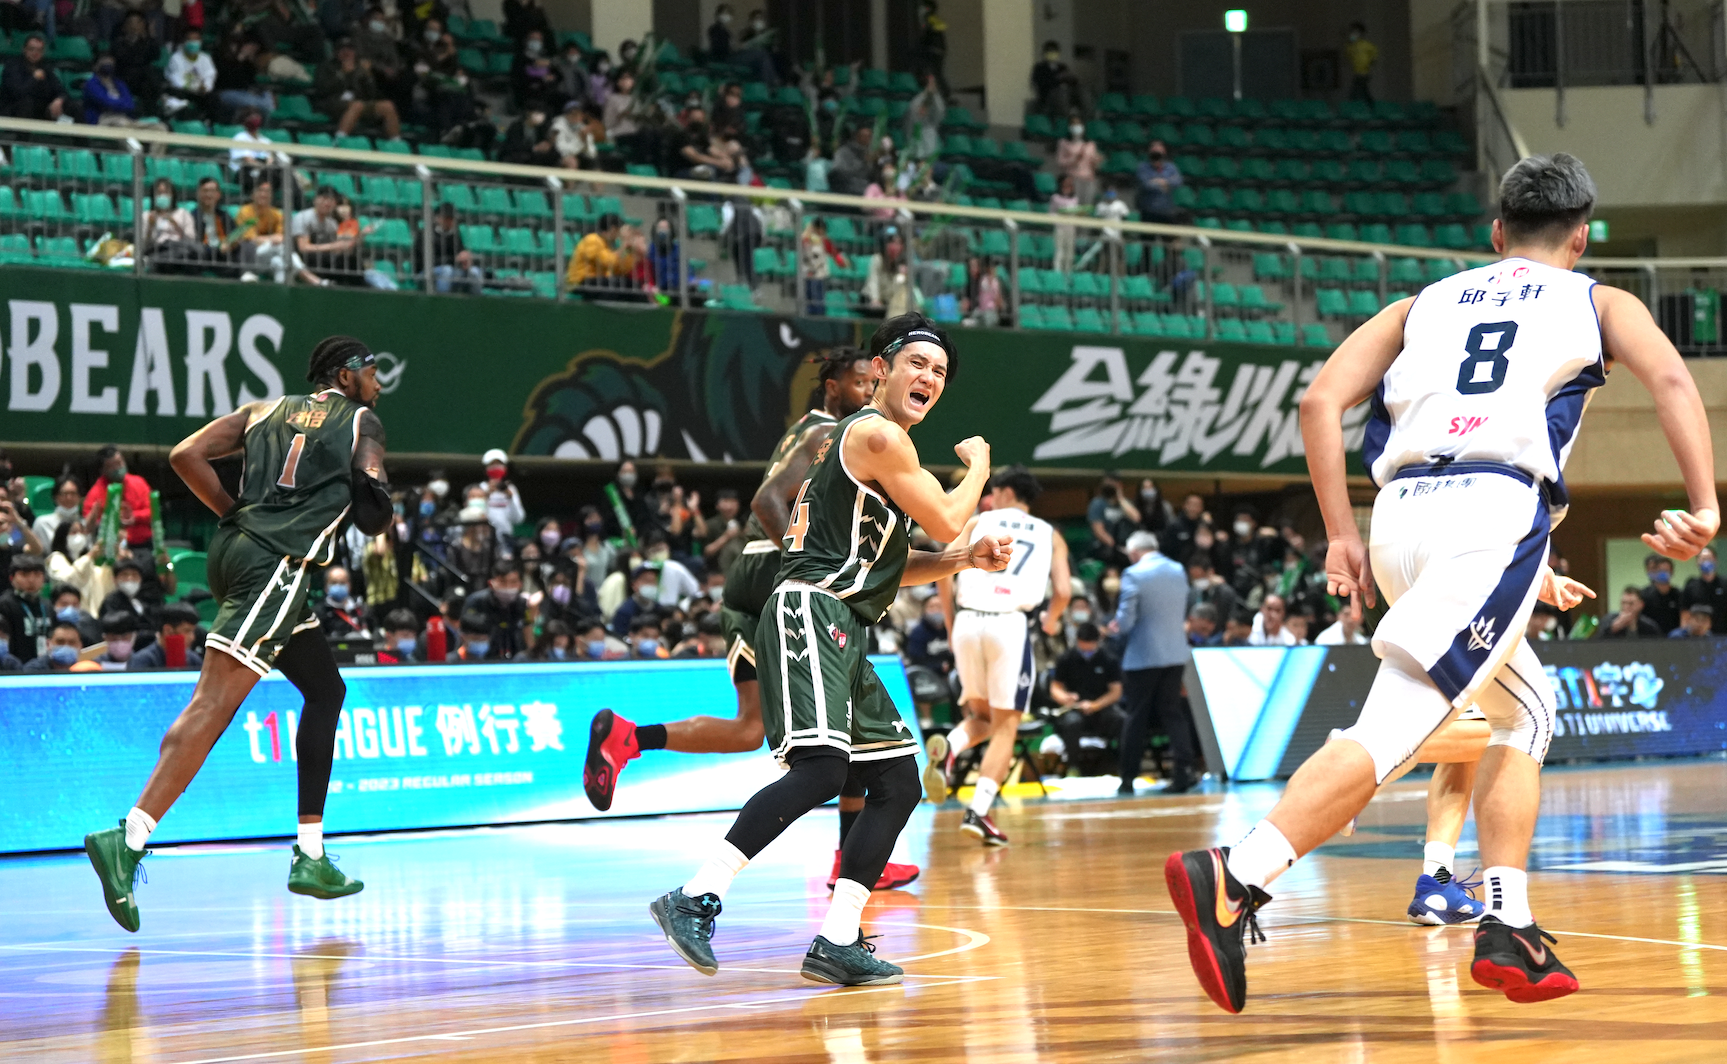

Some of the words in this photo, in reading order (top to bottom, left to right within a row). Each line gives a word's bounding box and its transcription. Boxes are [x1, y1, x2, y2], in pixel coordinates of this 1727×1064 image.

[1457, 283, 1547, 307] 邱子軒
[0, 299, 285, 418] BEARS
[1456, 320, 1519, 395] 8
[276, 433, 306, 488] 1
[782, 478, 811, 552] 4
[242, 710, 282, 763] t1
[286, 704, 427, 762] LAGUE
[435, 700, 564, 757] 例行賽
[358, 777, 400, 793] 2023
[402, 774, 471, 790] REGULAR
[473, 770, 534, 787] SEASON
